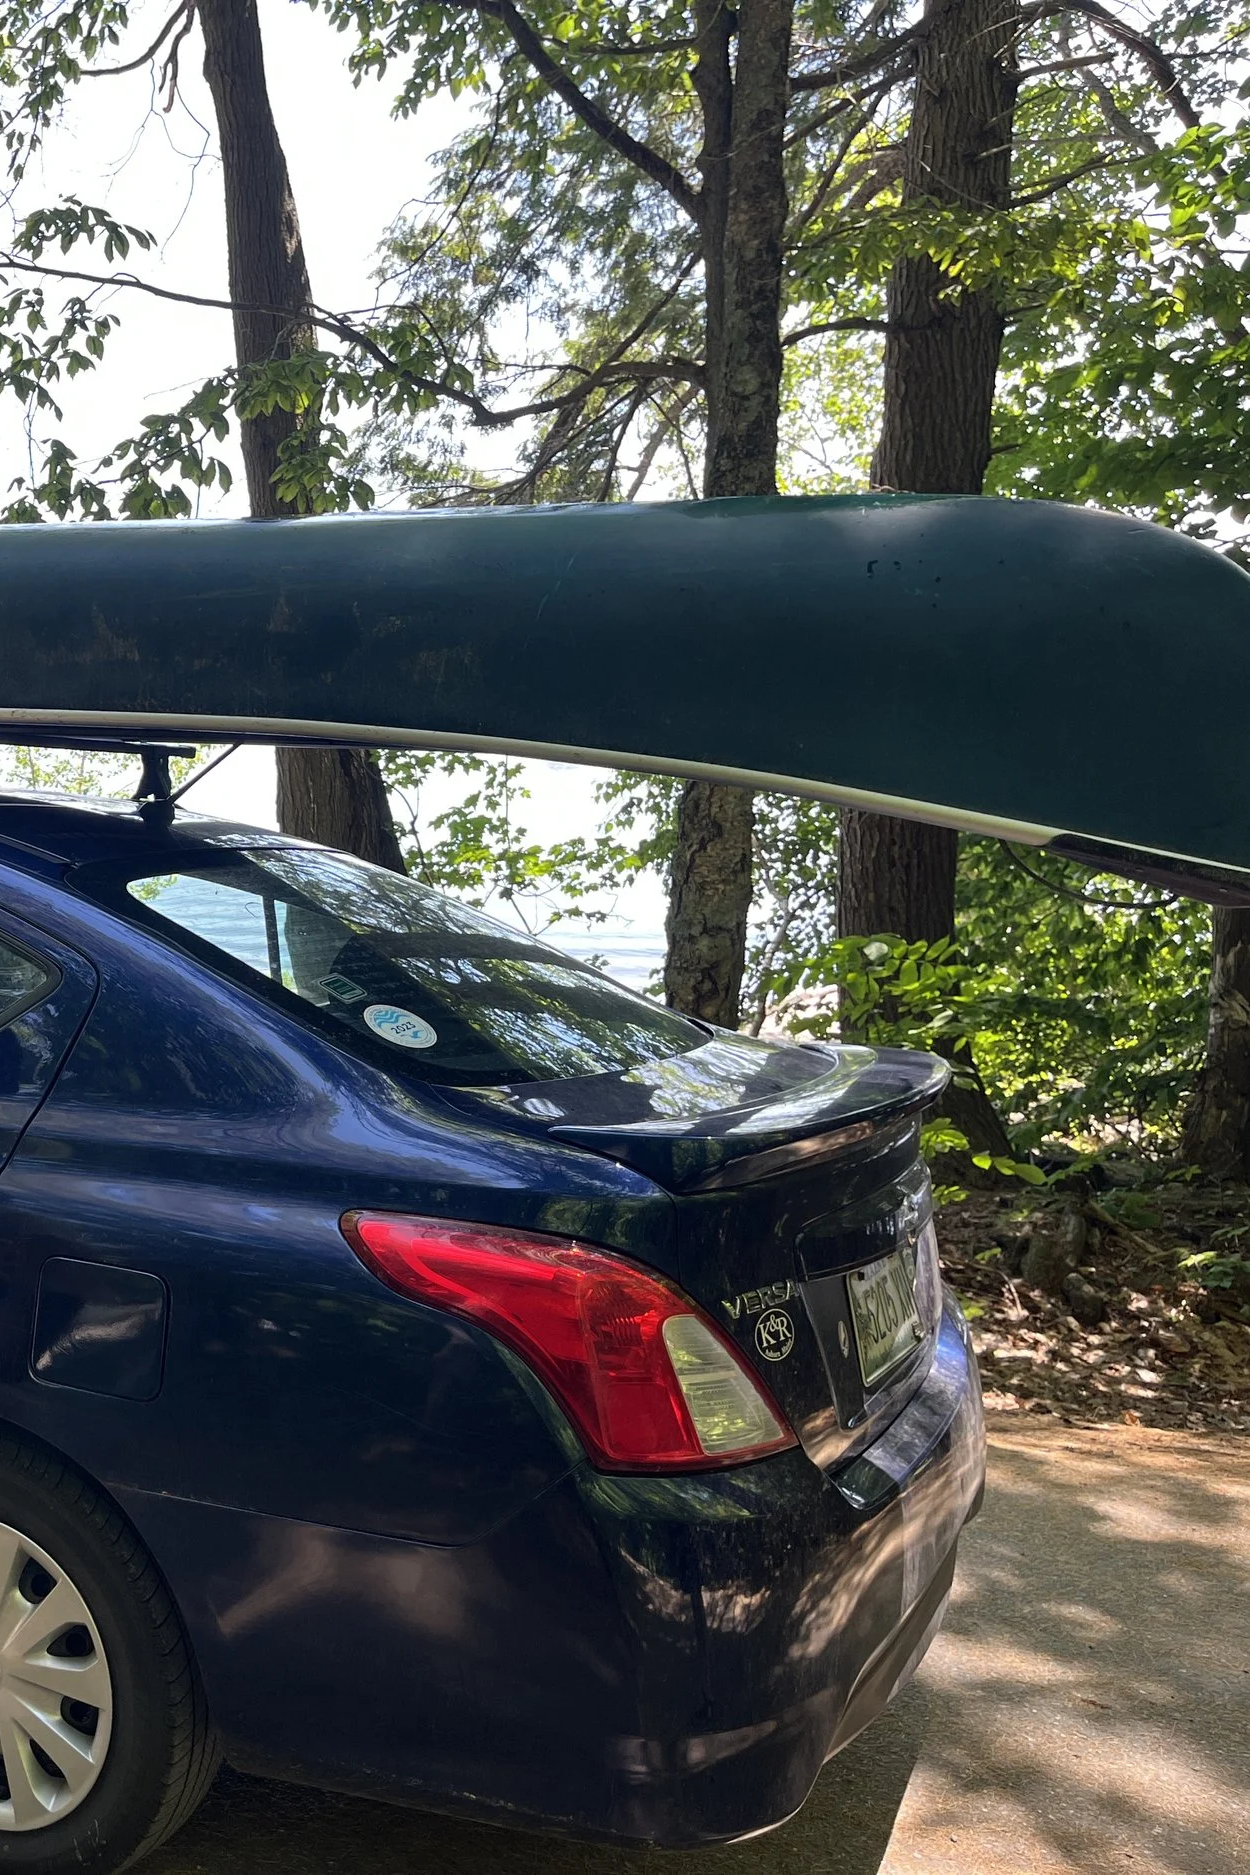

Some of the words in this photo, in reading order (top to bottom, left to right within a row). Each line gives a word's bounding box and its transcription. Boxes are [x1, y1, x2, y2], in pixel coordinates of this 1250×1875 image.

[390, 1021, 416, 1034] 2023
[721, 1279, 801, 1320] VERSA
[862, 1273, 899, 1344] 5205
[758, 1314, 793, 1348] K&R
